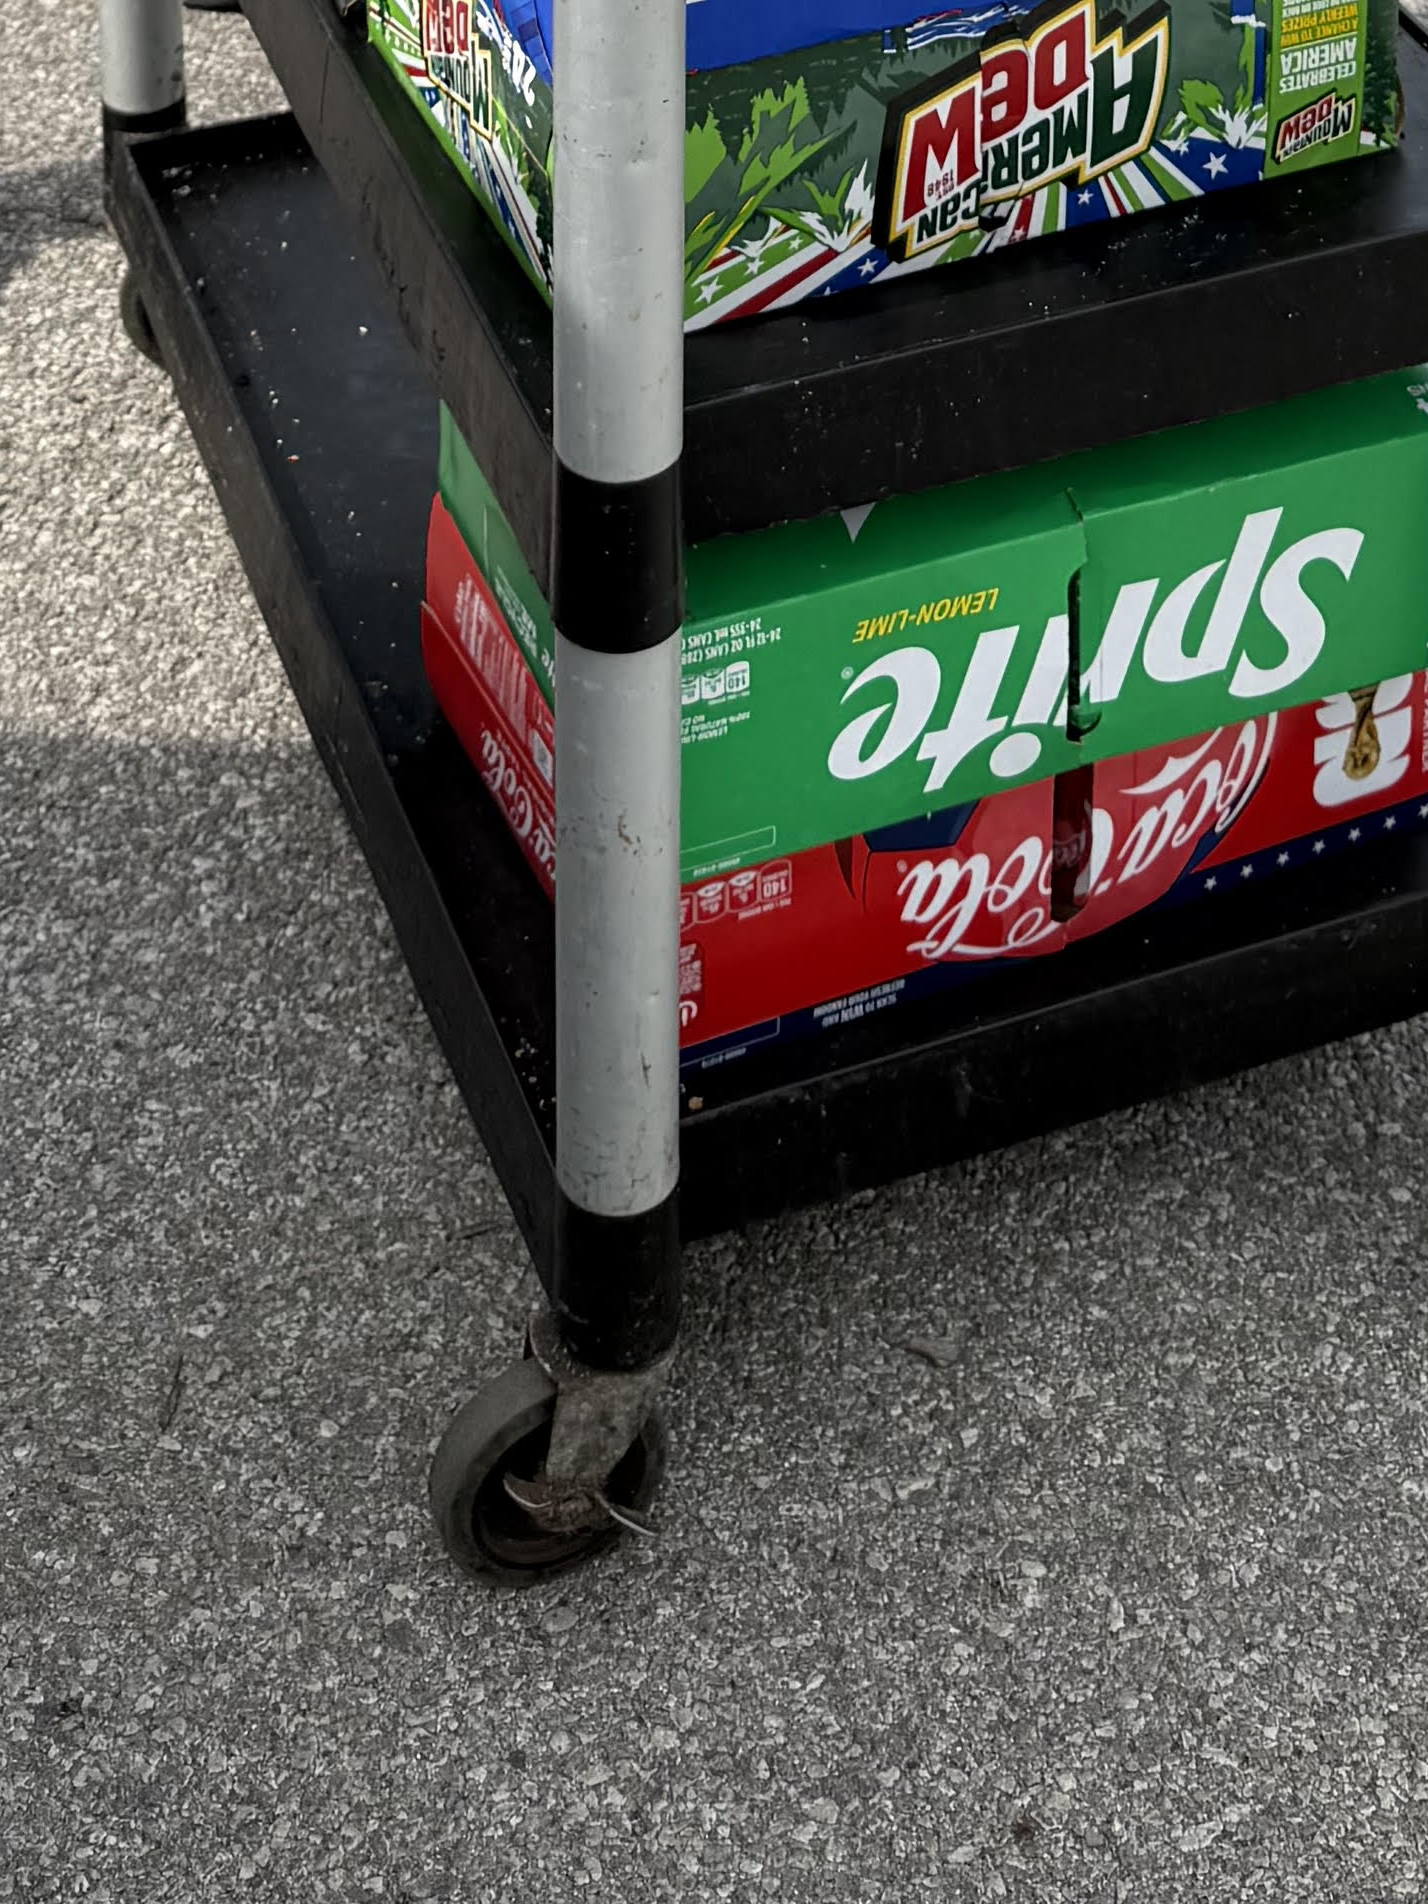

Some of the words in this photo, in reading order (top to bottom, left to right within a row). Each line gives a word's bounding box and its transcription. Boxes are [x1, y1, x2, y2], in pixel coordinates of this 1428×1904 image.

[1280, 13, 1319, 33] PRIZES
[1319, 3, 1358, 25] WEEKLY
[1280, 36, 1358, 77] AMERICA
[1279, 60, 1357, 95] CELEBRATES
[926, 169, 954, 197] 1948
[851, 587, 1000, 645] LEMON-LIME
[687, 630, 713, 650] CANS
[704, 641, 730, 660] CANS
[731, 638, 744, 653] OZ
[827, 506, 1365, 794] Sprite
[727, 673, 747, 690] 140
[896, 710, 1279, 959] Coca-Cola
[762, 878, 788, 898] 140
